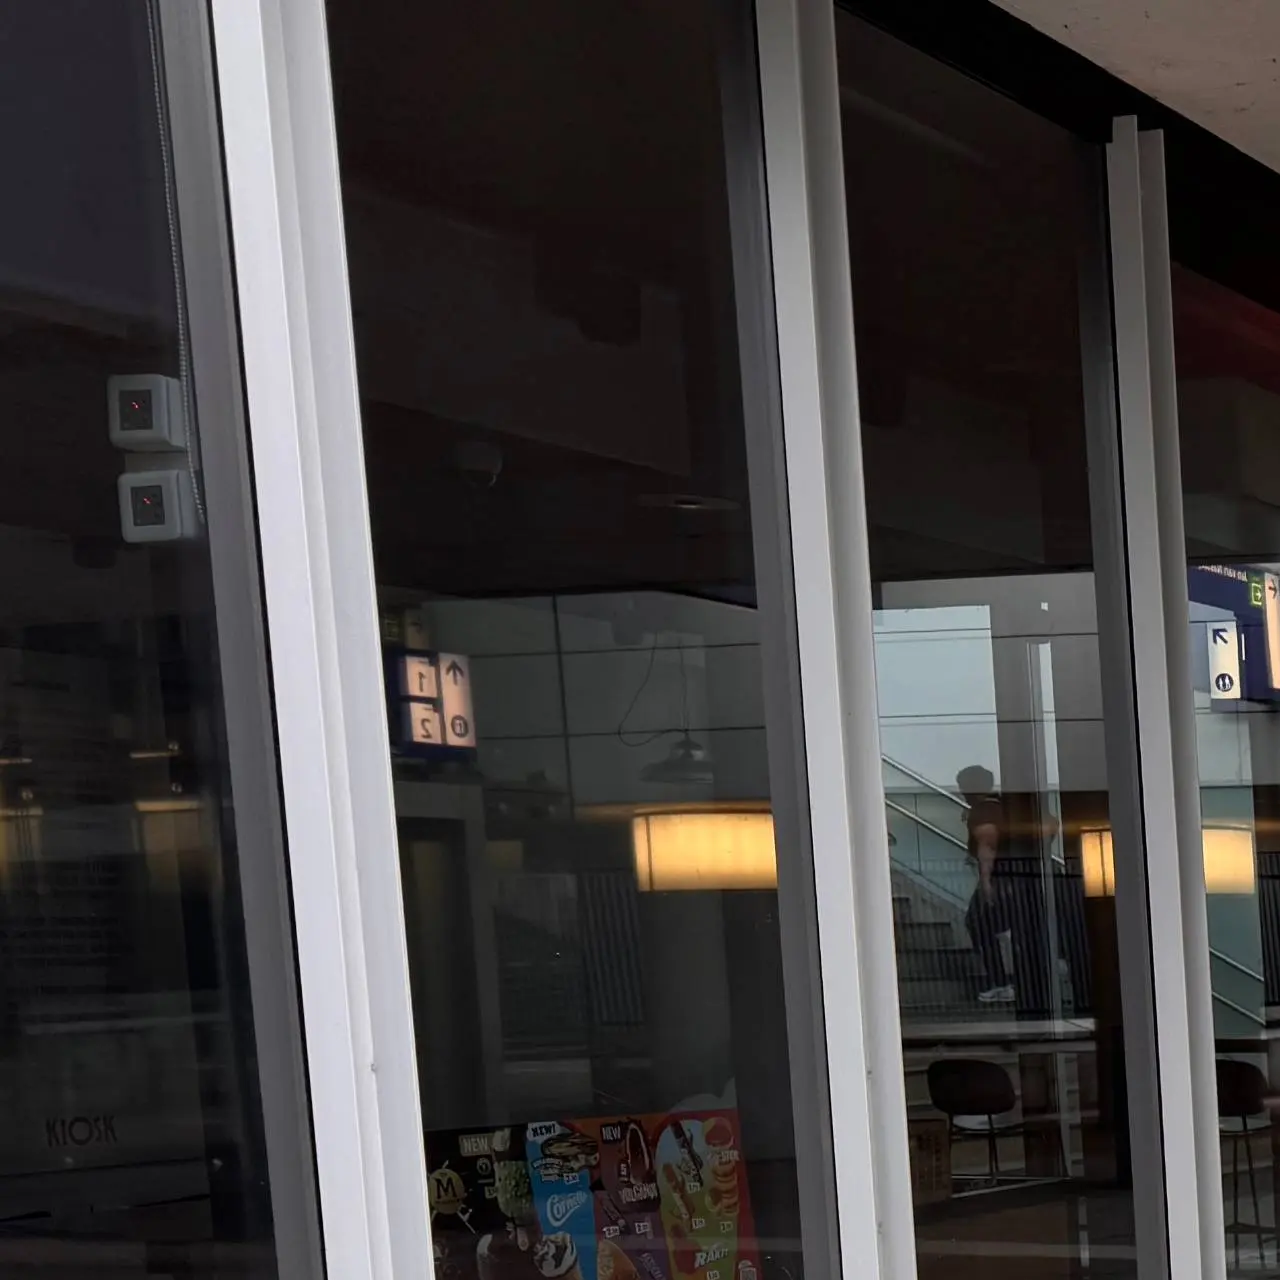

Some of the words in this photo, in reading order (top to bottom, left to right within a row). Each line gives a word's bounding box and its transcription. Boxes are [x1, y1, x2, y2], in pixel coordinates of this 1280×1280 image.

[46, 1115, 118, 1147] KIOSK
[602, 1125, 621, 1141] NEW
[462, 1136, 488, 1153] NEW
[436, 1177, 457, 1199] M
